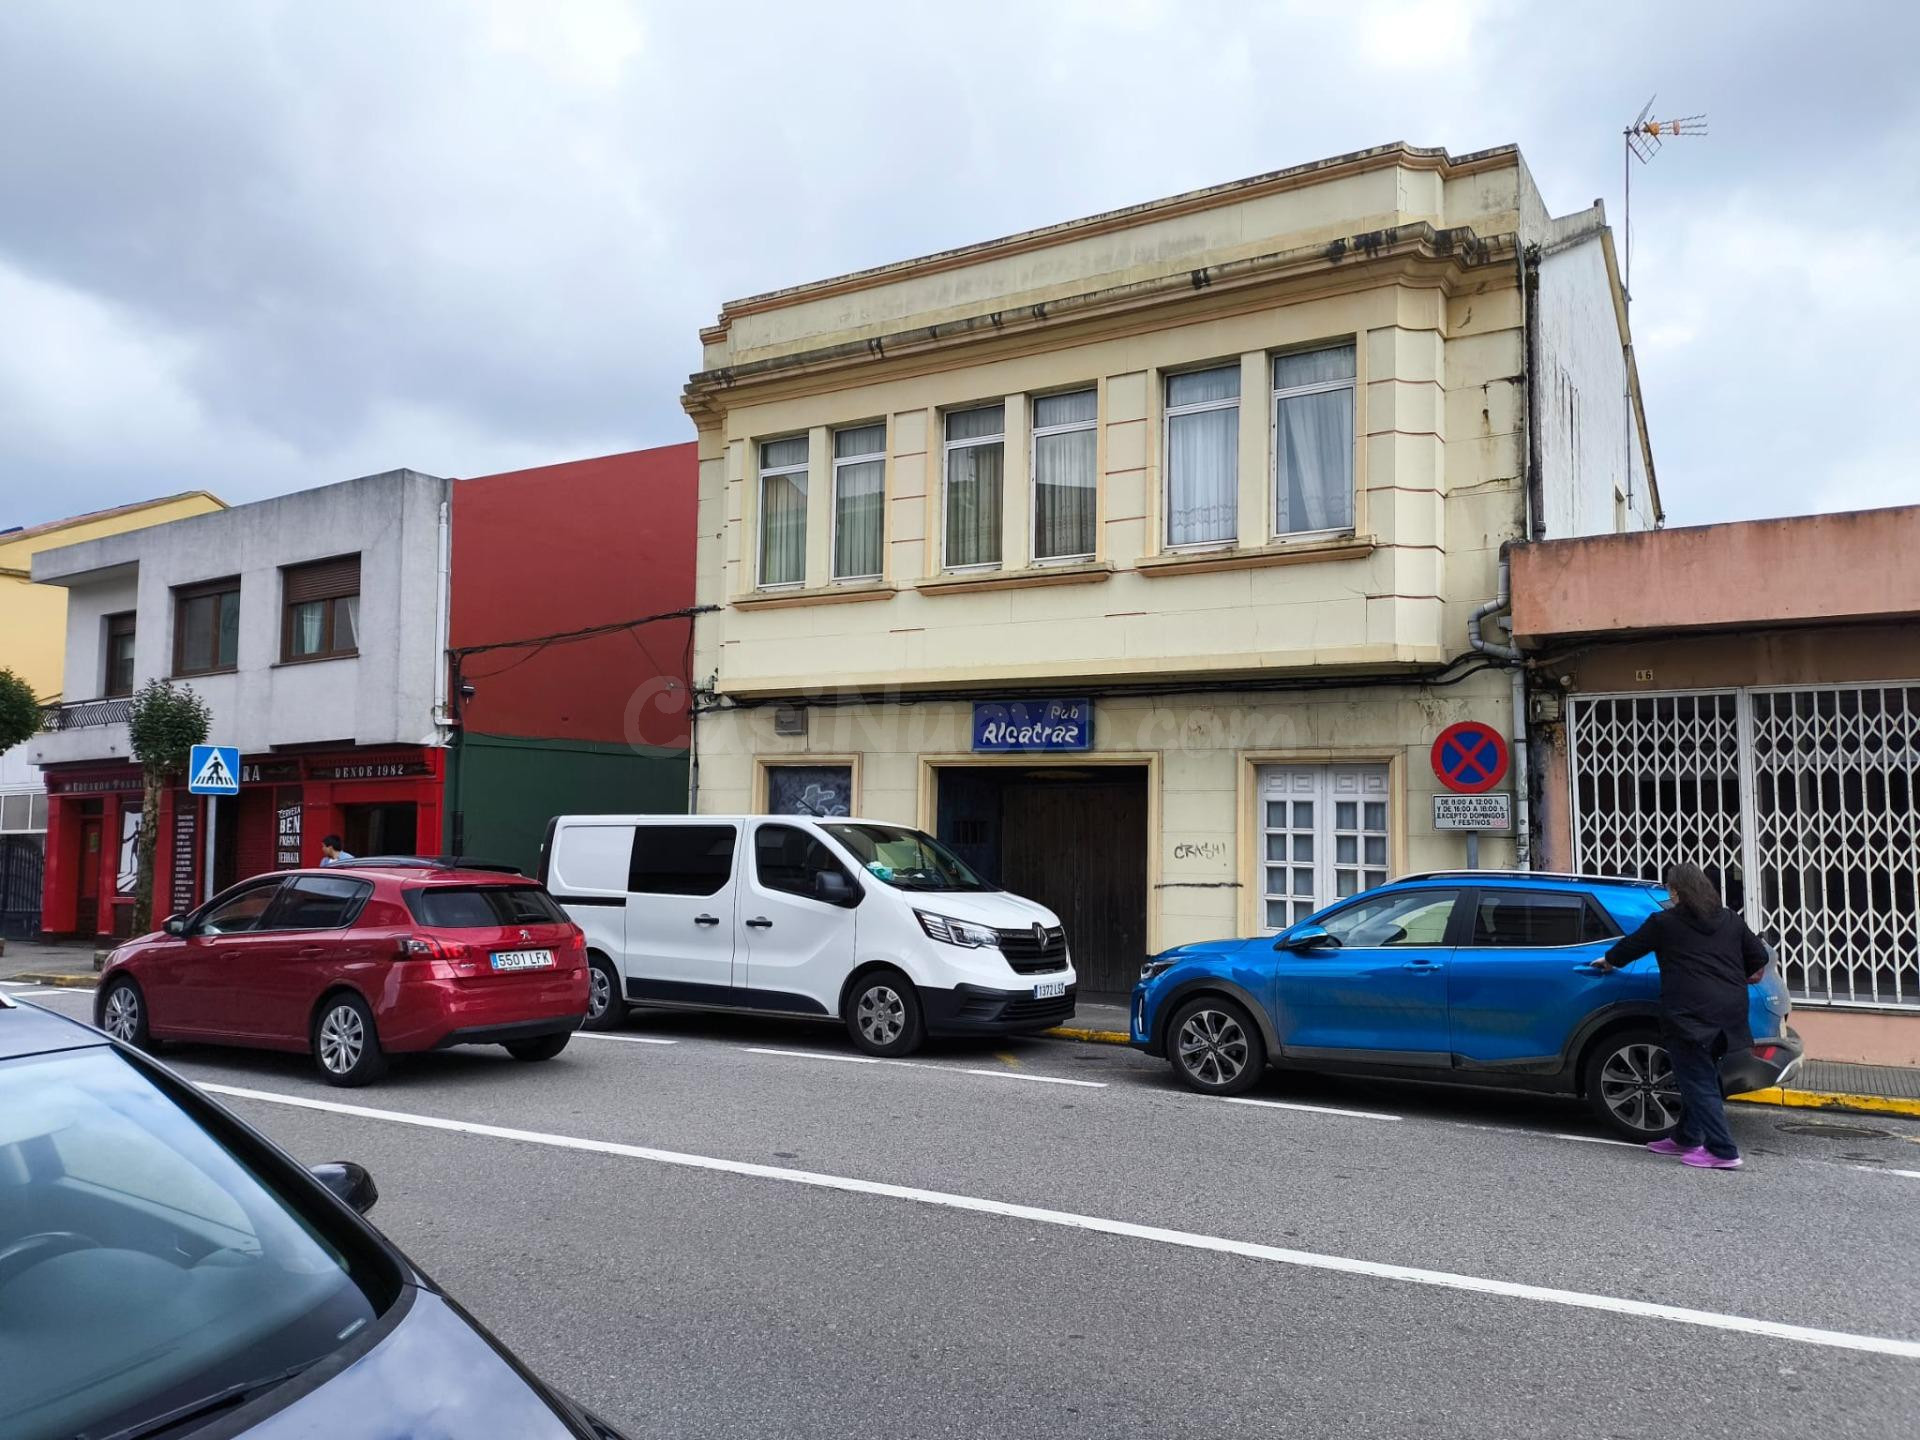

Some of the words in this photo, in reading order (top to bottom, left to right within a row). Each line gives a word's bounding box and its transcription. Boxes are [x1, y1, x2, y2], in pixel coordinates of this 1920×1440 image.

[1637, 670, 1652, 680] 46
[982, 722, 1079, 744] Alcatraz
[242, 764, 261, 782] RA
[377, 763, 404, 776] 1982
[279, 814, 301, 834] BEN
[497, 953, 527, 967] 5501
[529, 951, 551, 965] LFK
[1039, 985, 1053, 997] 1372
